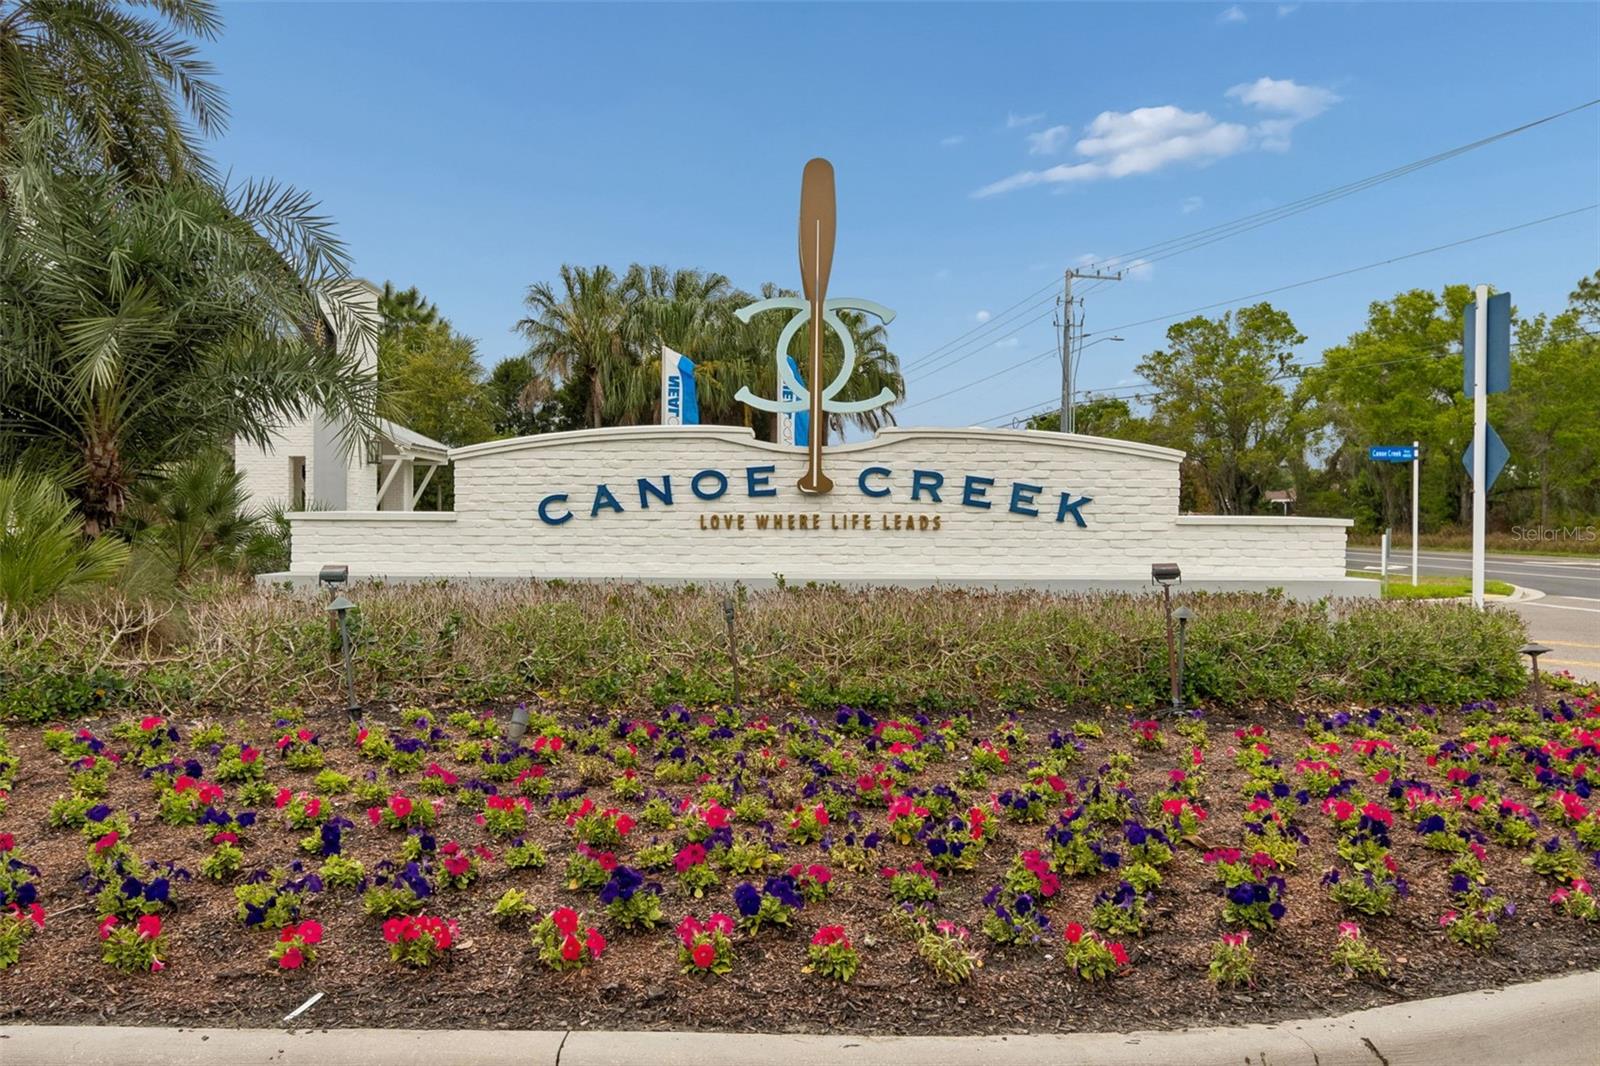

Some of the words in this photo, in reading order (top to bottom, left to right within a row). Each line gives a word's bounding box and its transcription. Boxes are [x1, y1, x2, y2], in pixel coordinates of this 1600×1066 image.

[1388, 449, 1402, 457] Creek
[537, 465, 777, 525] CANOE
[858, 466, 1093, 528] CREEK
[700, 514, 745, 530] LOVE
[756, 514, 821, 530] WHERE
[831, 514, 871, 530] LIFE
[883, 514, 942, 530] LEADS
